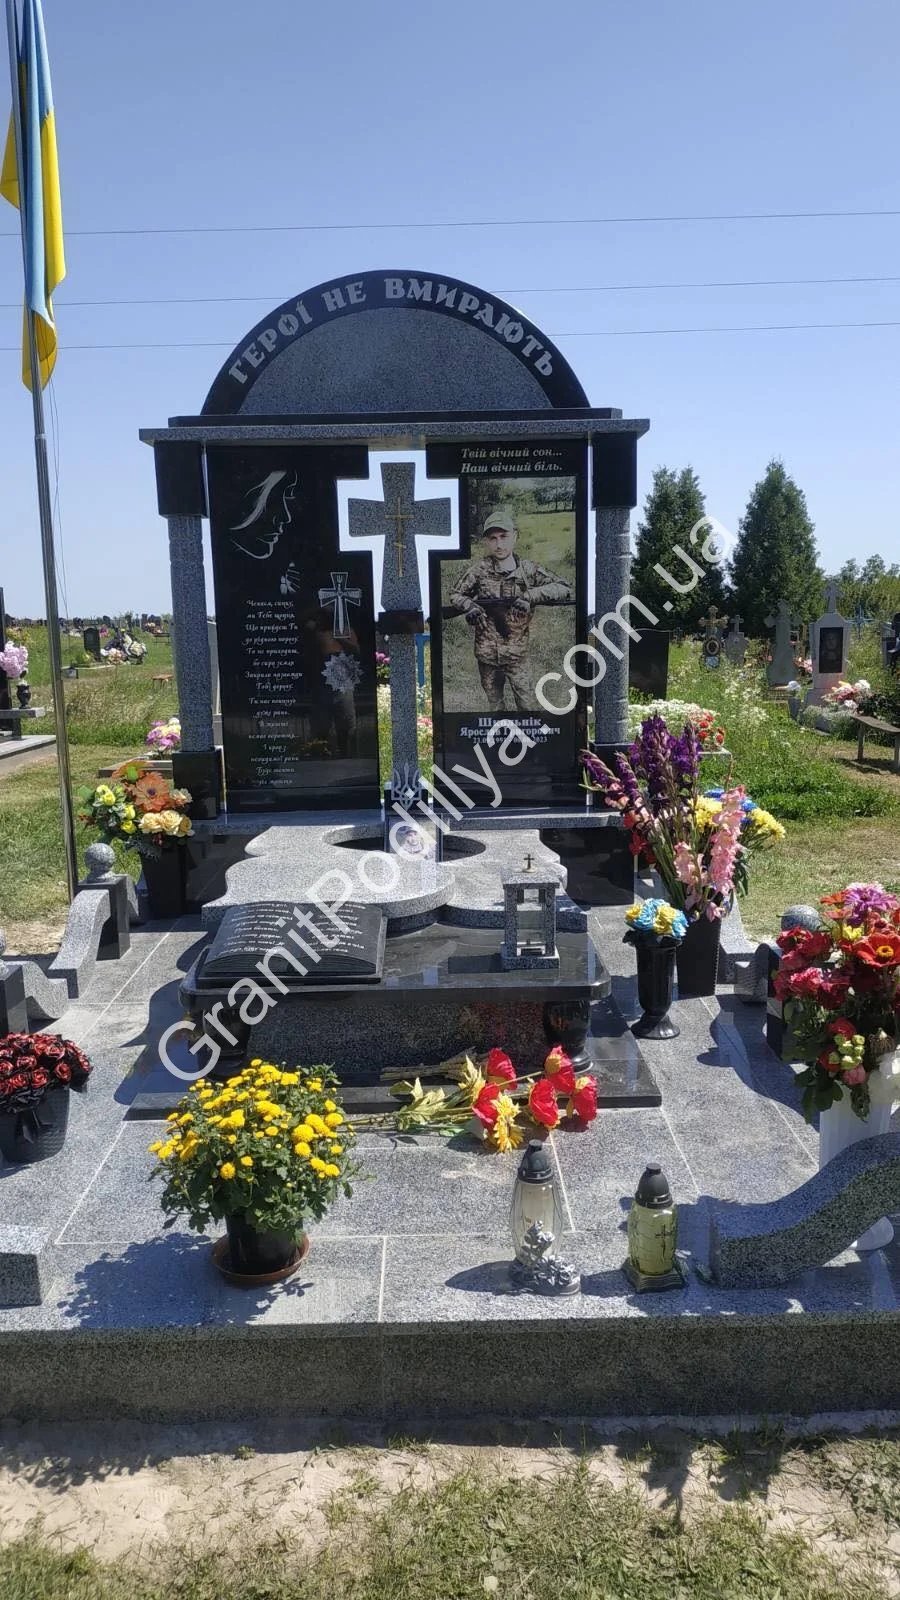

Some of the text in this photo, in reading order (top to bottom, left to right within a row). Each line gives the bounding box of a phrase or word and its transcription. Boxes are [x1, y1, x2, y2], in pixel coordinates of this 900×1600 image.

[229, 278, 554, 384] ГЕРОЇ НЕ ВМИРАЮТЬ
[461, 447, 563, 459] Твій вічний сон...
[461, 461, 563, 473] Наш вічний біль.
